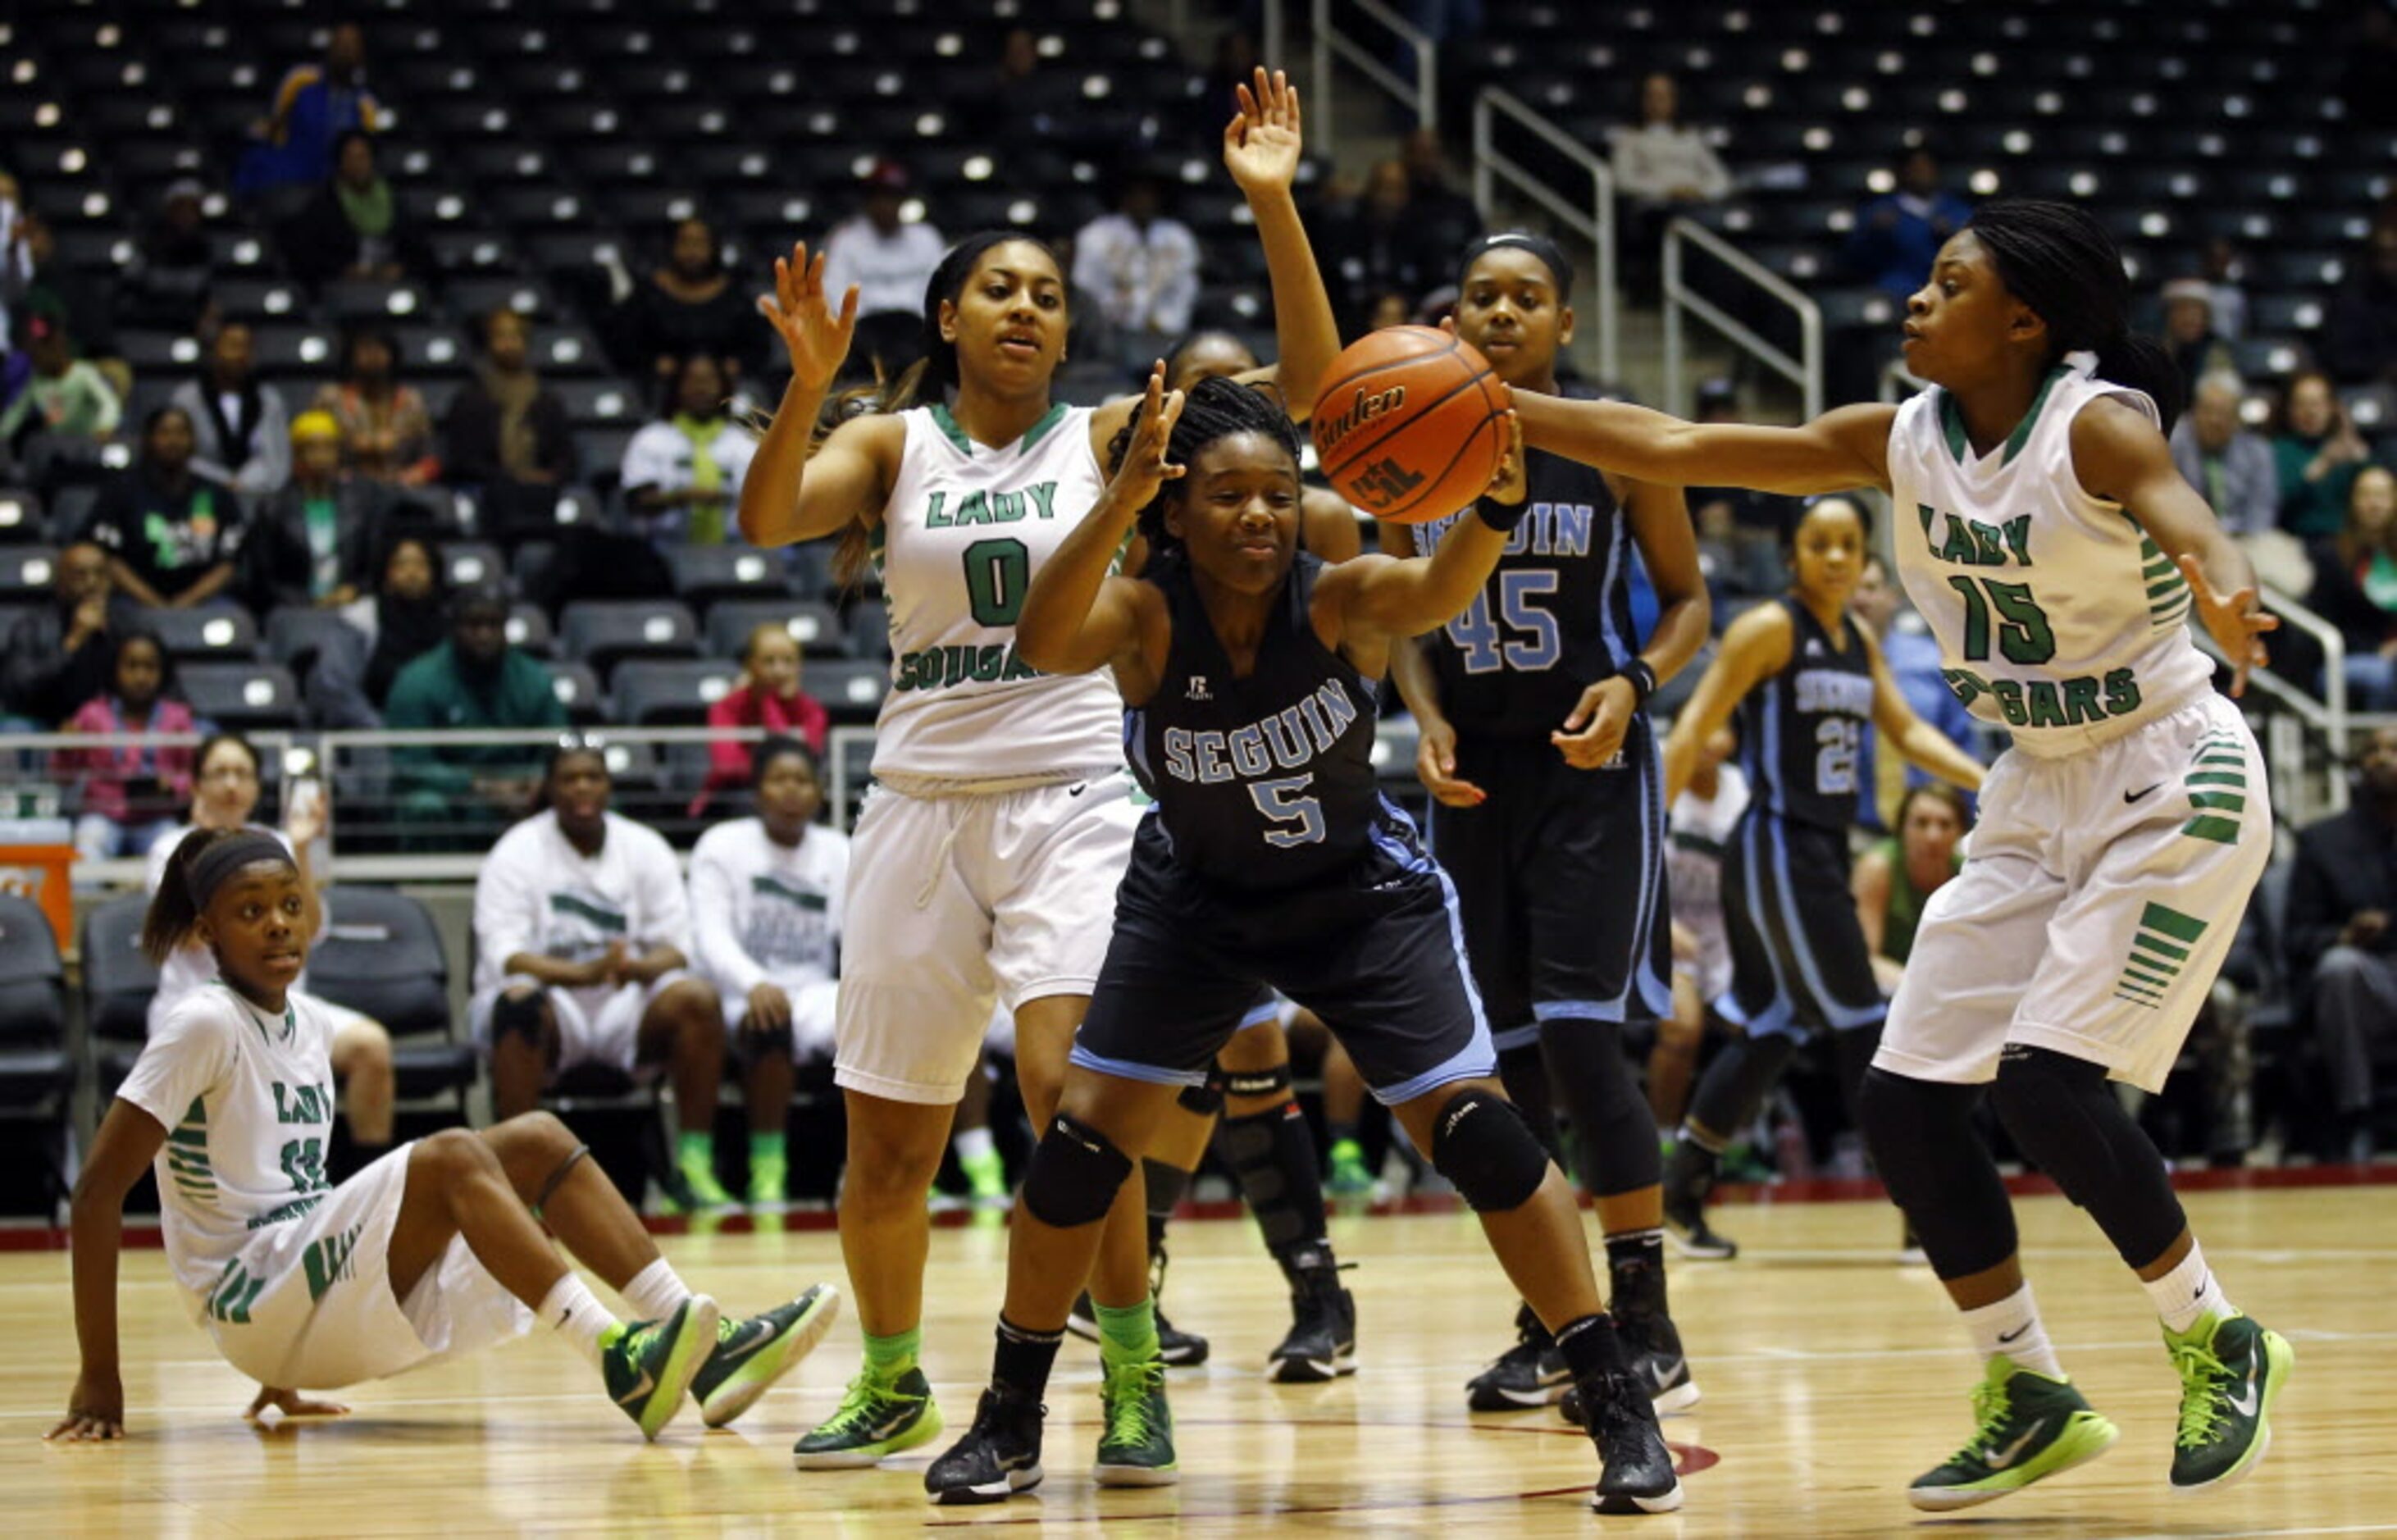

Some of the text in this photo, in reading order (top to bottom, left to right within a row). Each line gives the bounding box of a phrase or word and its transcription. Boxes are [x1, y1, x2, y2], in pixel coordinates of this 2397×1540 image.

[925, 481, 1059, 529] LADY
[1916, 502, 2032, 567] LADY
[962, 537, 1030, 628] 0
[1445, 569, 1562, 675] 45
[1947, 575, 2057, 666] 15
[1163, 677, 1358, 784] SEGUIN
[1246, 771, 1326, 849] 5
